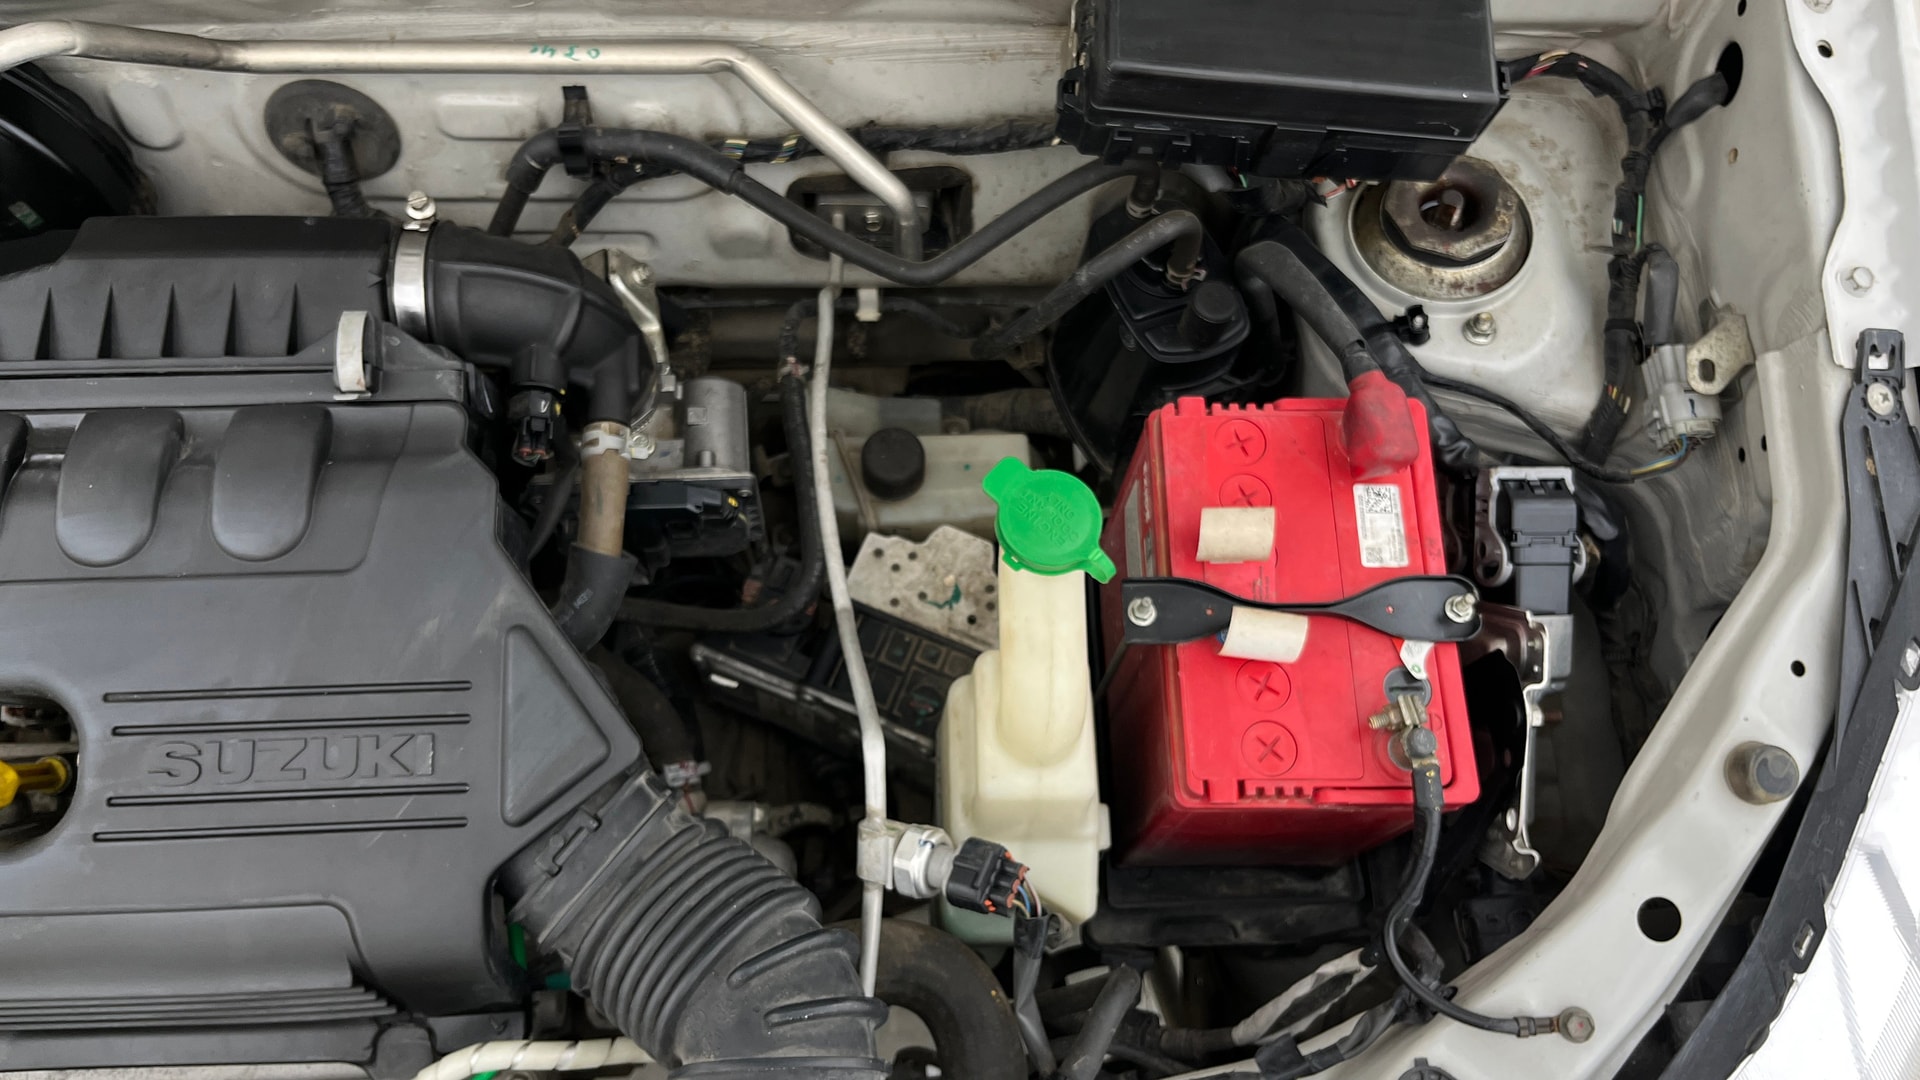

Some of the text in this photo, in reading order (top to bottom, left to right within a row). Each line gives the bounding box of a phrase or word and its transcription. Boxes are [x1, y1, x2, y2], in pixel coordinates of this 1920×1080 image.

[1016, 501, 1066, 546] ENGINE
[1021, 488, 1080, 543] COOLANT
[1045, 491, 1075, 520] ONLY
[147, 732, 436, 787] SUZUKI
